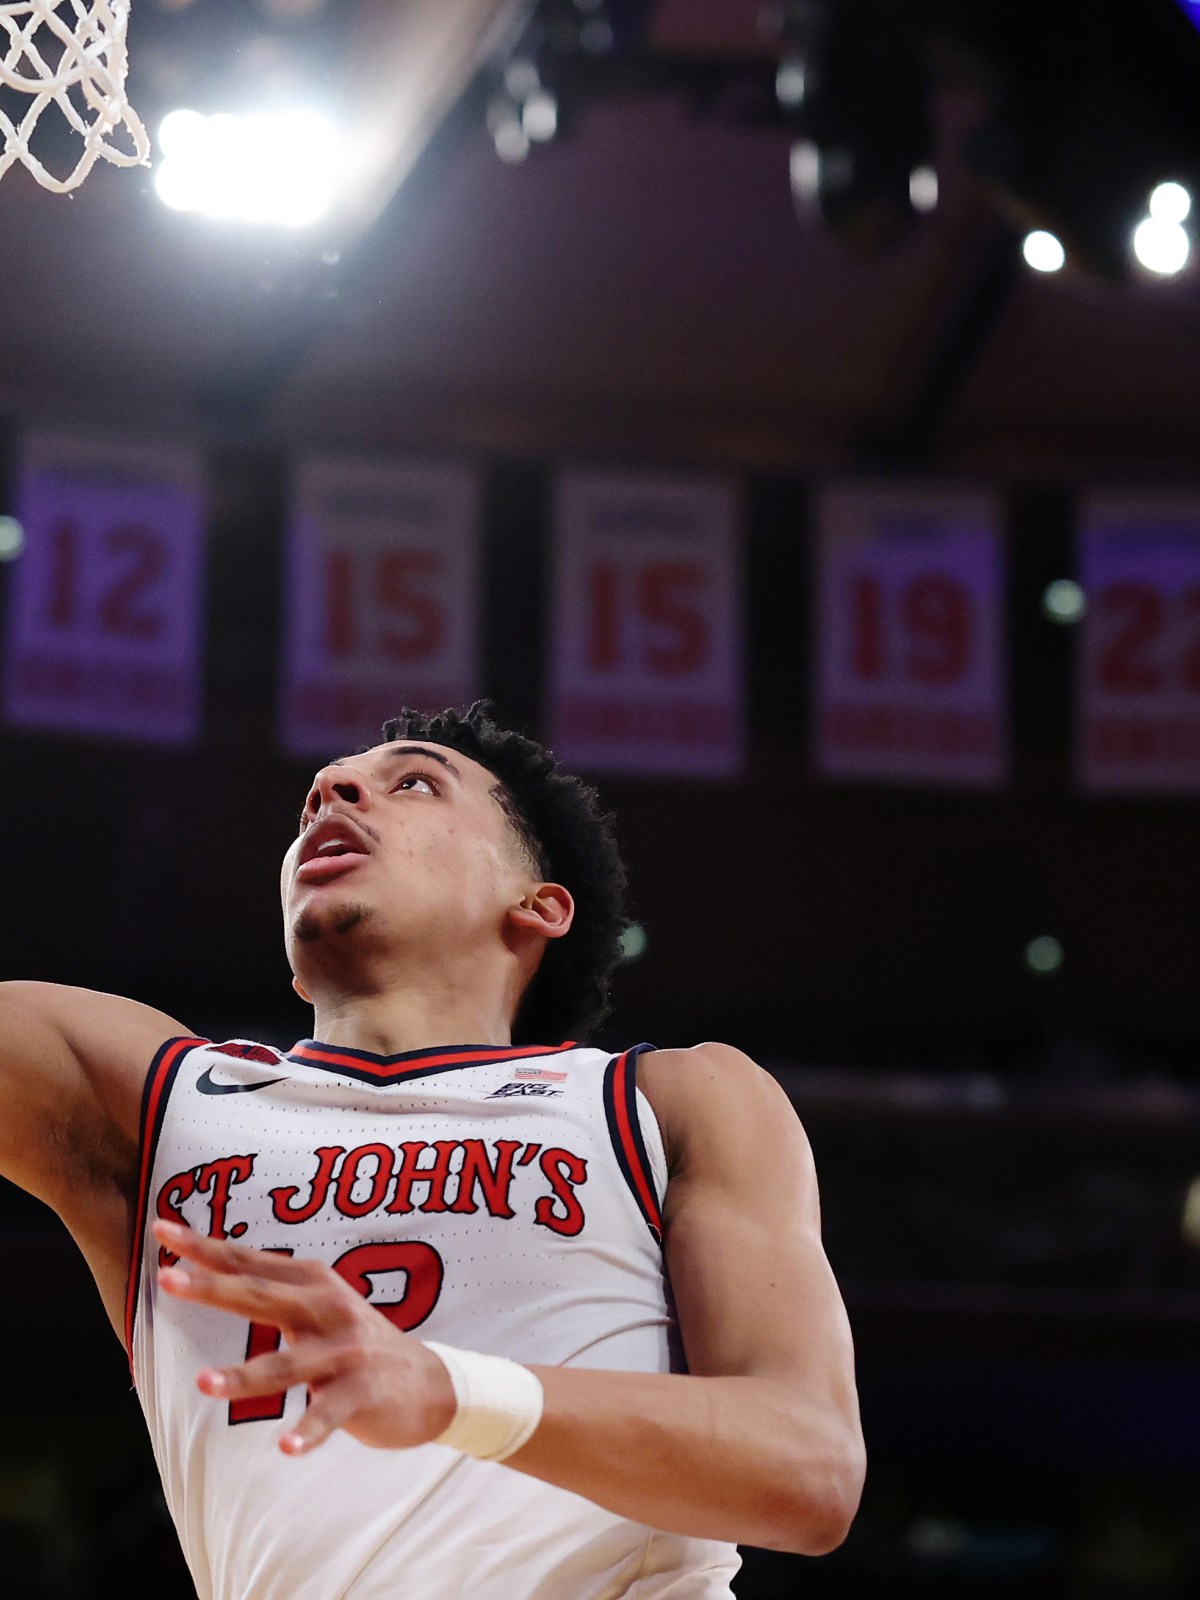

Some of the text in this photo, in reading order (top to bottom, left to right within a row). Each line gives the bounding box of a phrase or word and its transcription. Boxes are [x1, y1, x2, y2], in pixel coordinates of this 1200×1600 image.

[49, 519, 168, 639] 12
[324, 546, 446, 663] 15
[587, 561, 711, 677] 15
[853, 571, 973, 688] 19
[1101, 579, 1200, 694] 2
[156, 1139, 588, 1268] ST. JOHN'S
